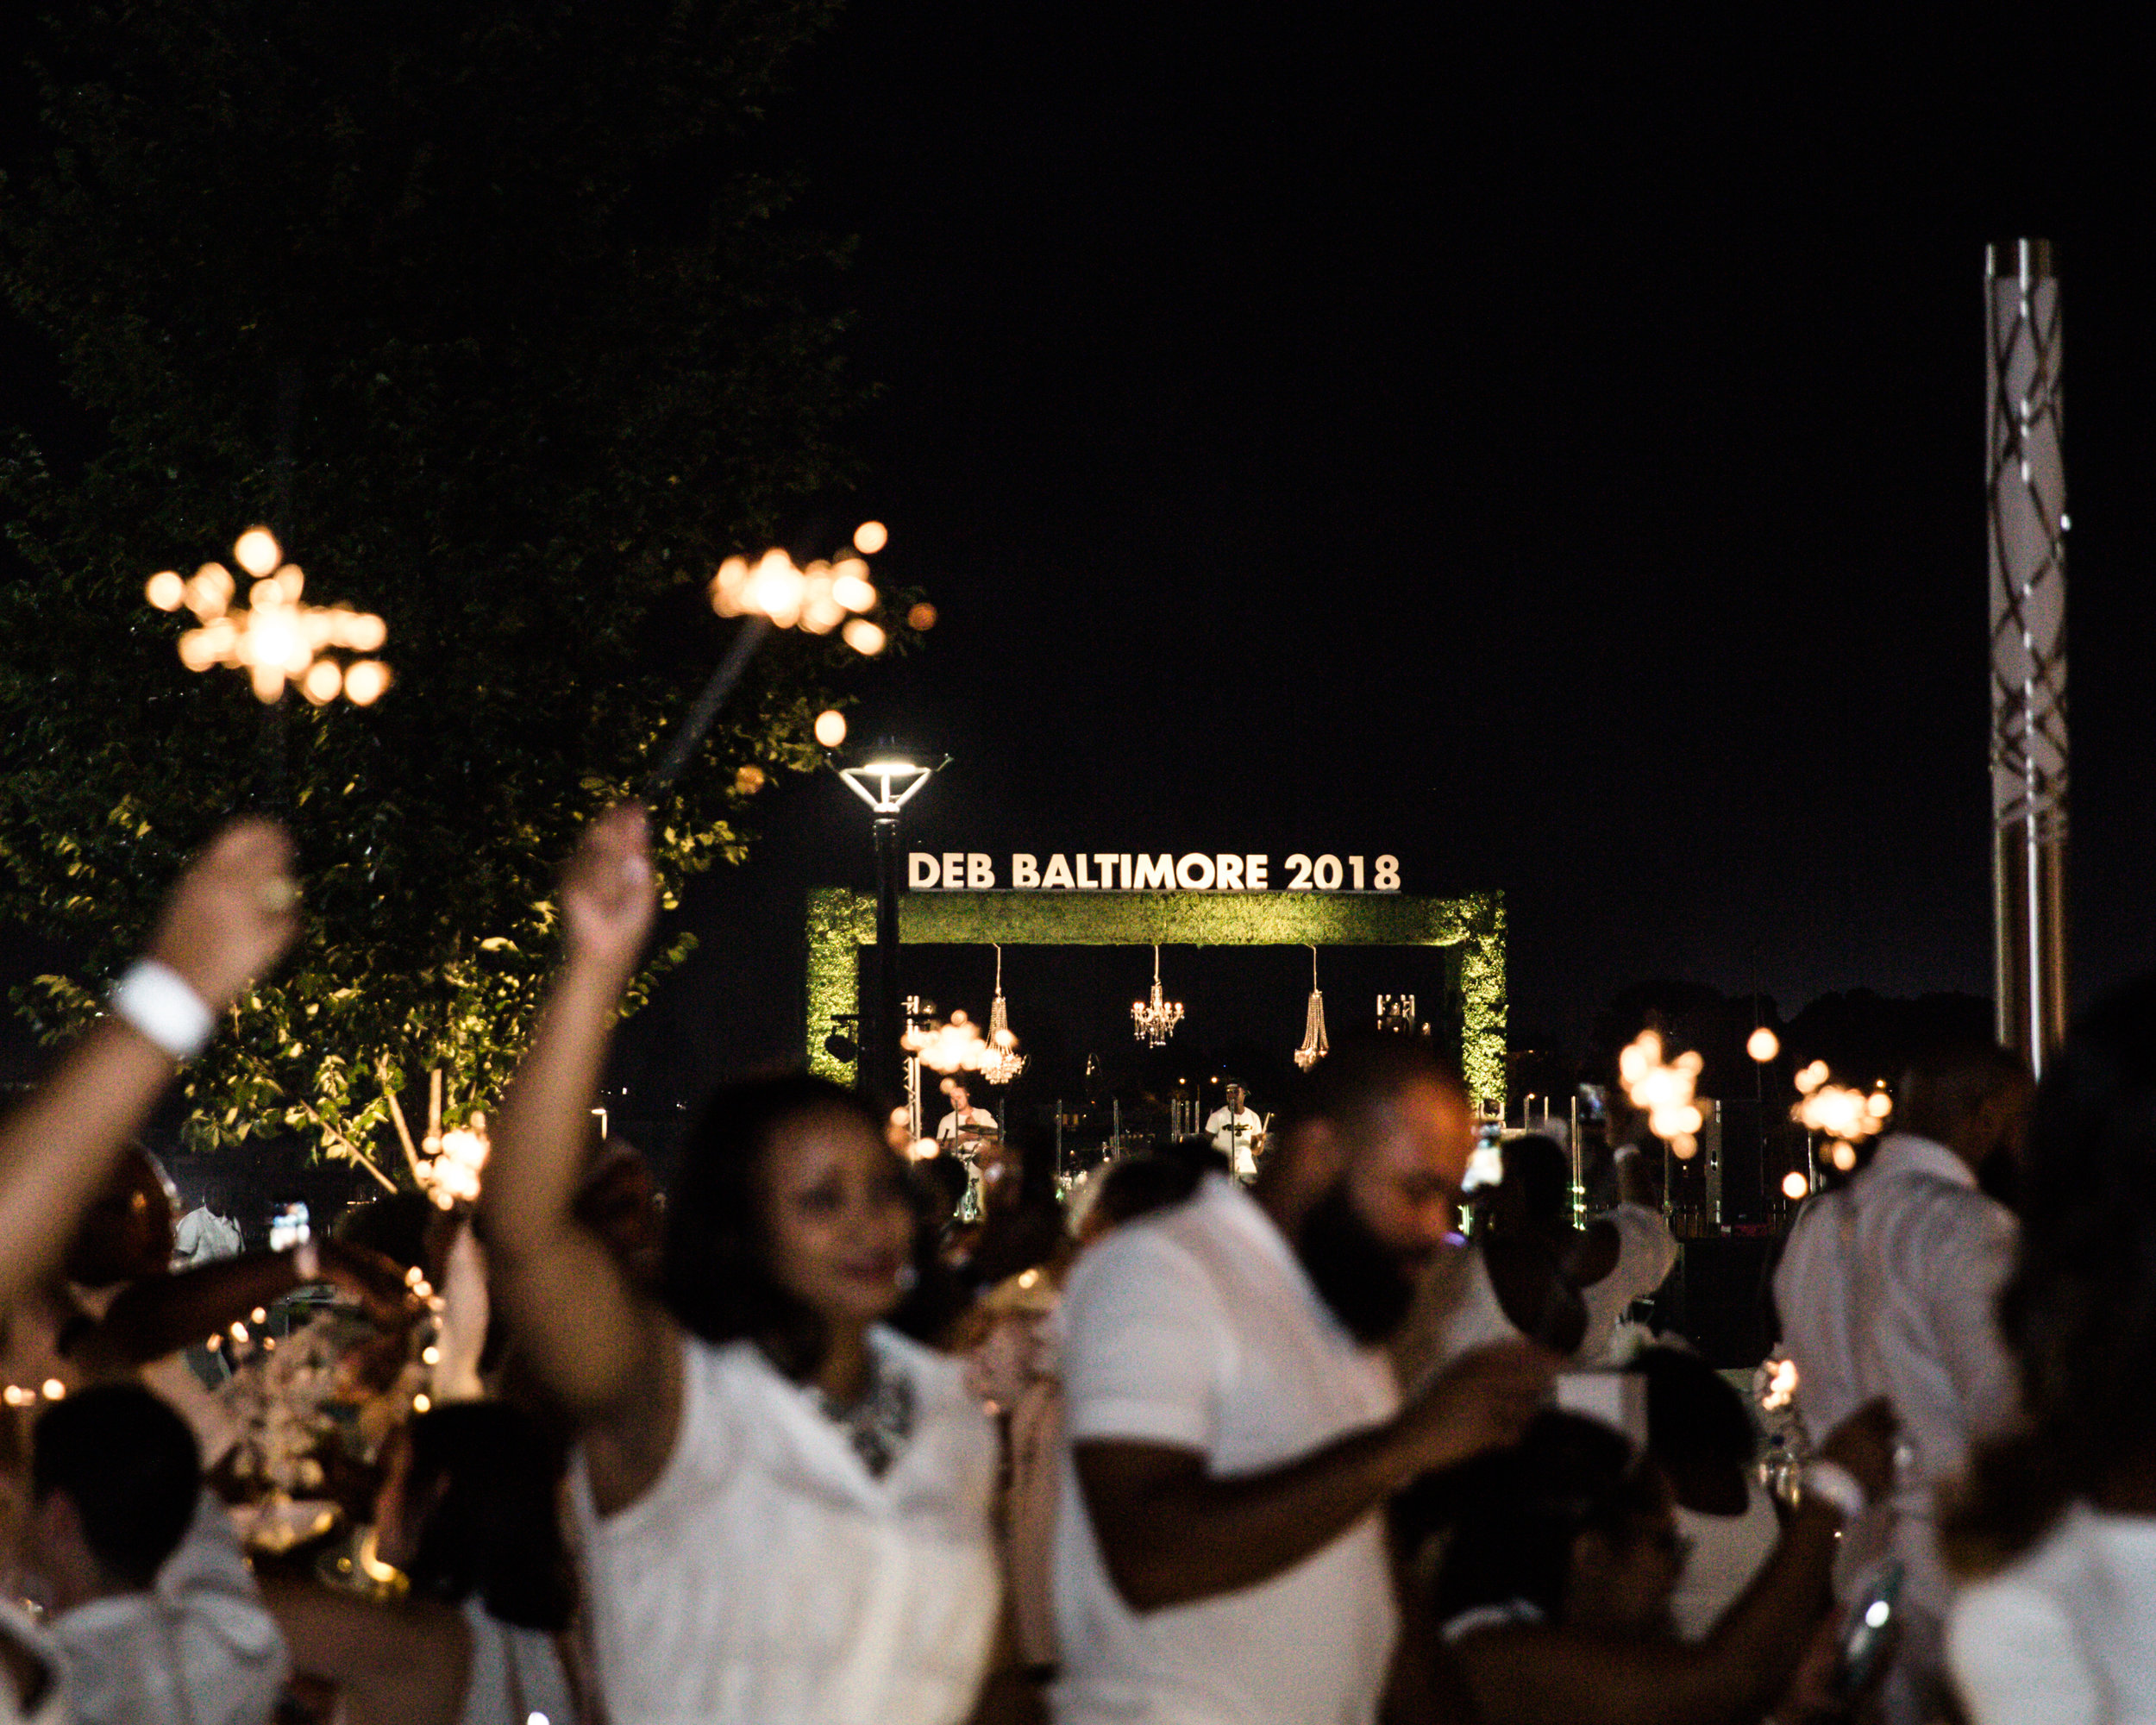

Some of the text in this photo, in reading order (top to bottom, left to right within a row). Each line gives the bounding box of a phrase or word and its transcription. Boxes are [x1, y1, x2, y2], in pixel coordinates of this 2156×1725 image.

[908, 852, 1401, 891] DEB BALTIMORE 2018
